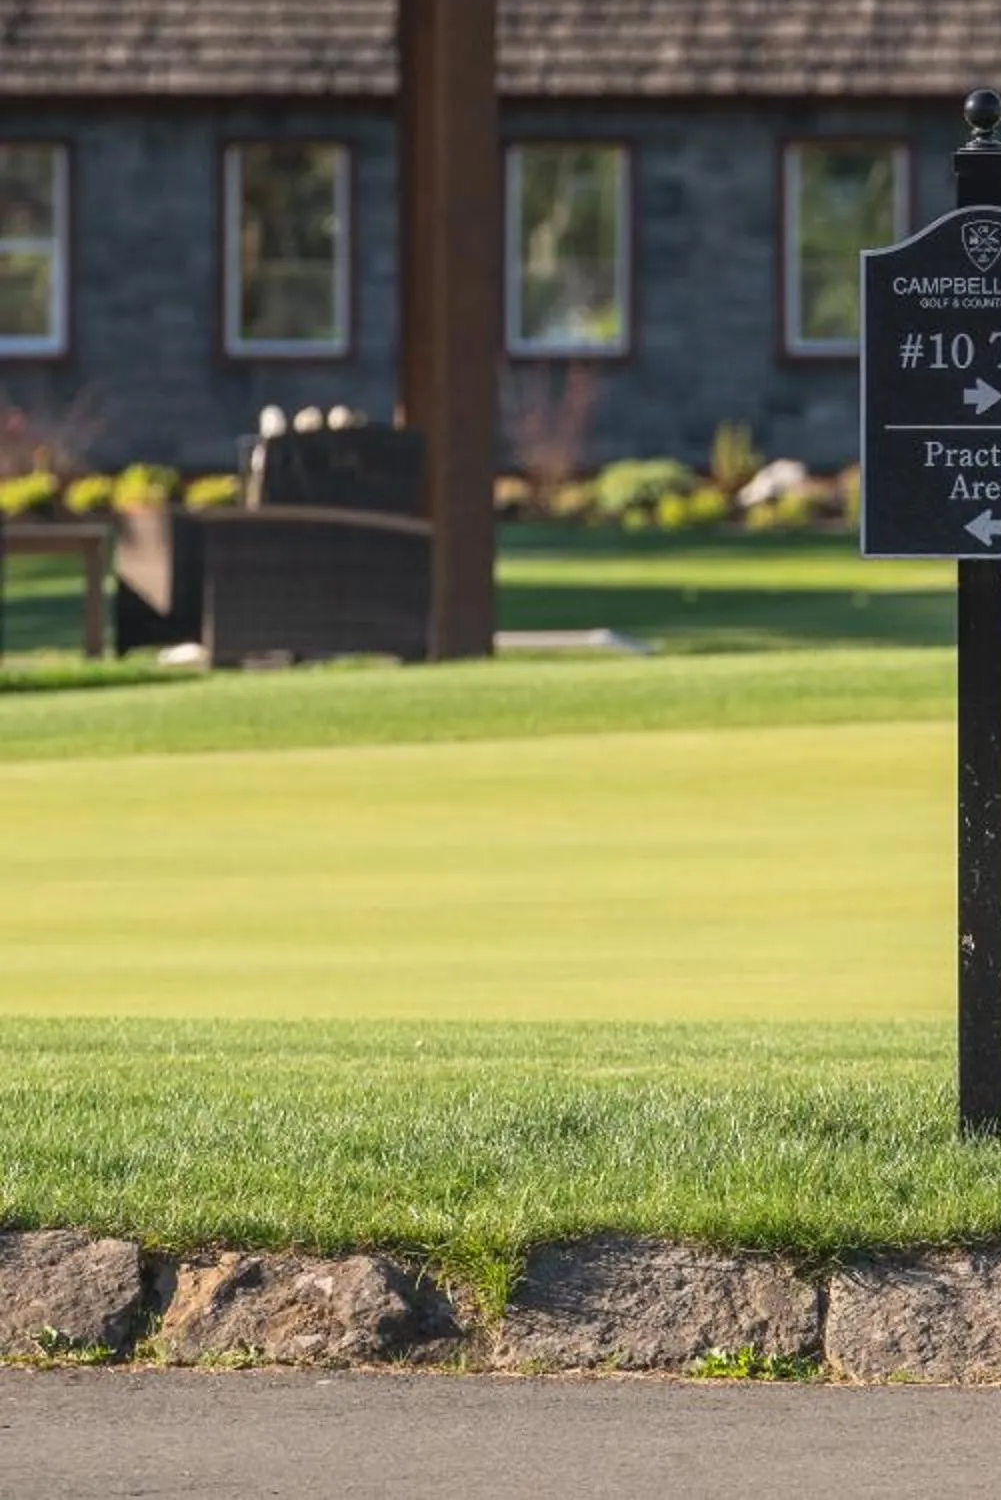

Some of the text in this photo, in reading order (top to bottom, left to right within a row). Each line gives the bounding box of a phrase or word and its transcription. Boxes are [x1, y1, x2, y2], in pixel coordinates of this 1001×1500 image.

[920, 297, 948, 308] GOLF
[952, 298, 960, 308] &
[900, 333, 974, 369] #10
